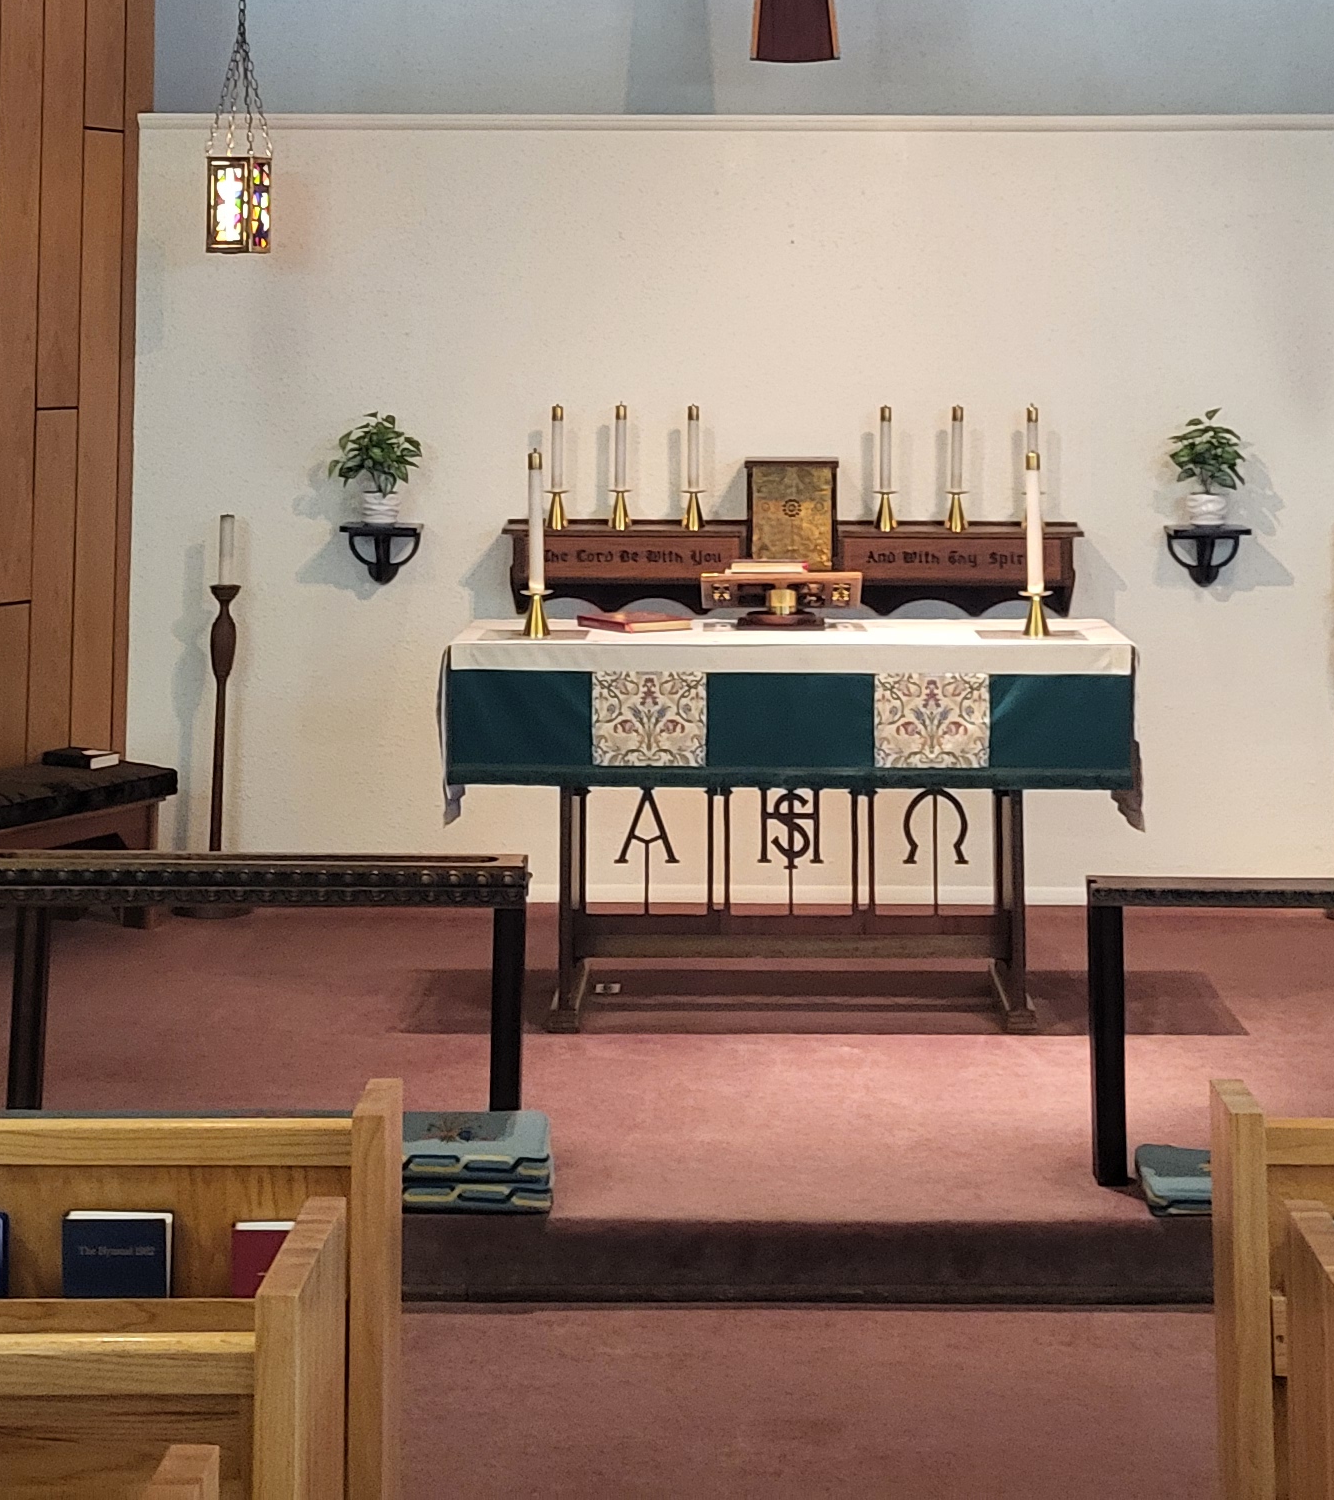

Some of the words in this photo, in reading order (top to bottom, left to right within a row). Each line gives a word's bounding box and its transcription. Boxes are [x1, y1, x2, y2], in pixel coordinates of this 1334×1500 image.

[646, 550, 684, 563] With
[690, 550, 722, 566] You
[867, 551, 896, 564] And
[902, 551, 940, 564] With
[988, 552, 1025, 568] Spir
